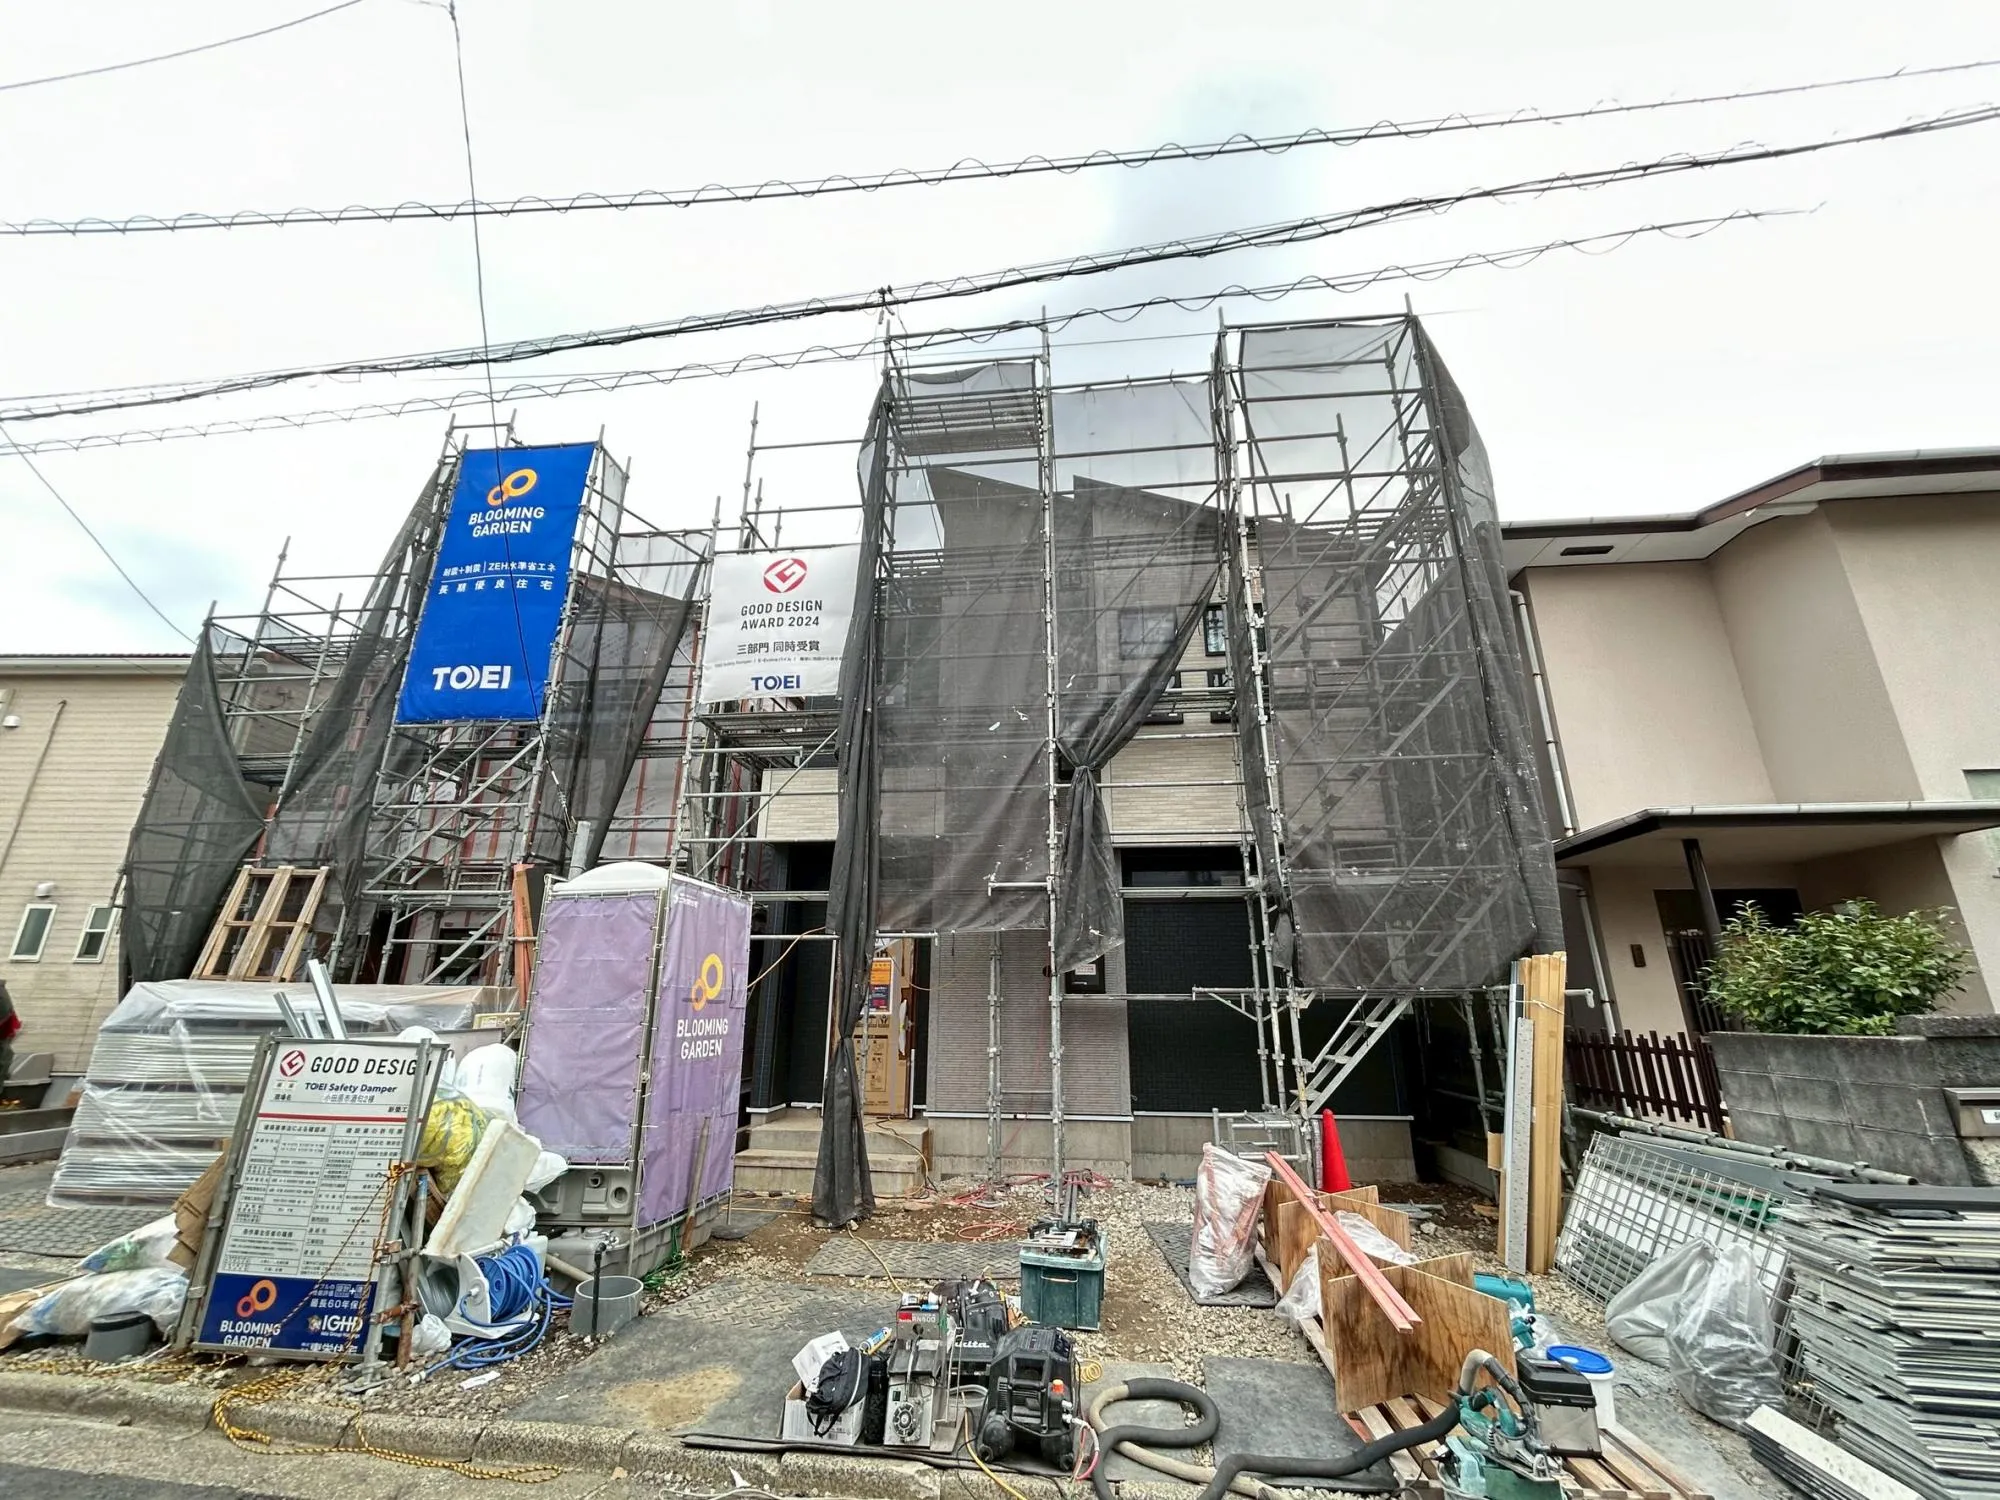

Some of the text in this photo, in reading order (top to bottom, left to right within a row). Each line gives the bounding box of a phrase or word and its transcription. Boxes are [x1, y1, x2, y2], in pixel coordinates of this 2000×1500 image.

[468, 506, 545, 526] BLOOMING
[472, 520, 532, 538] GARDEN
[741, 599, 823, 617] GOOD DESIGN
[741, 616, 820, 631] AWARD 2024
[737, 640, 820, 656] 三部門 同時受賞
[432, 664, 512, 691] TOEI
[751, 674, 801, 691] TOEI
[676, 1017, 729, 1038] BLOOMING
[681, 1039, 722, 1060] GARDEN
[310, 1056, 359, 1074] GOOD
[328, 1083, 358, 1094] Safety
[360, 1083, 398, 1095] Damper
[310, 1298, 364, 1310] 最長60年保
[220, 1320, 281, 1336] BLOOMING
[223, 1334, 272, 1349] GARDEN
